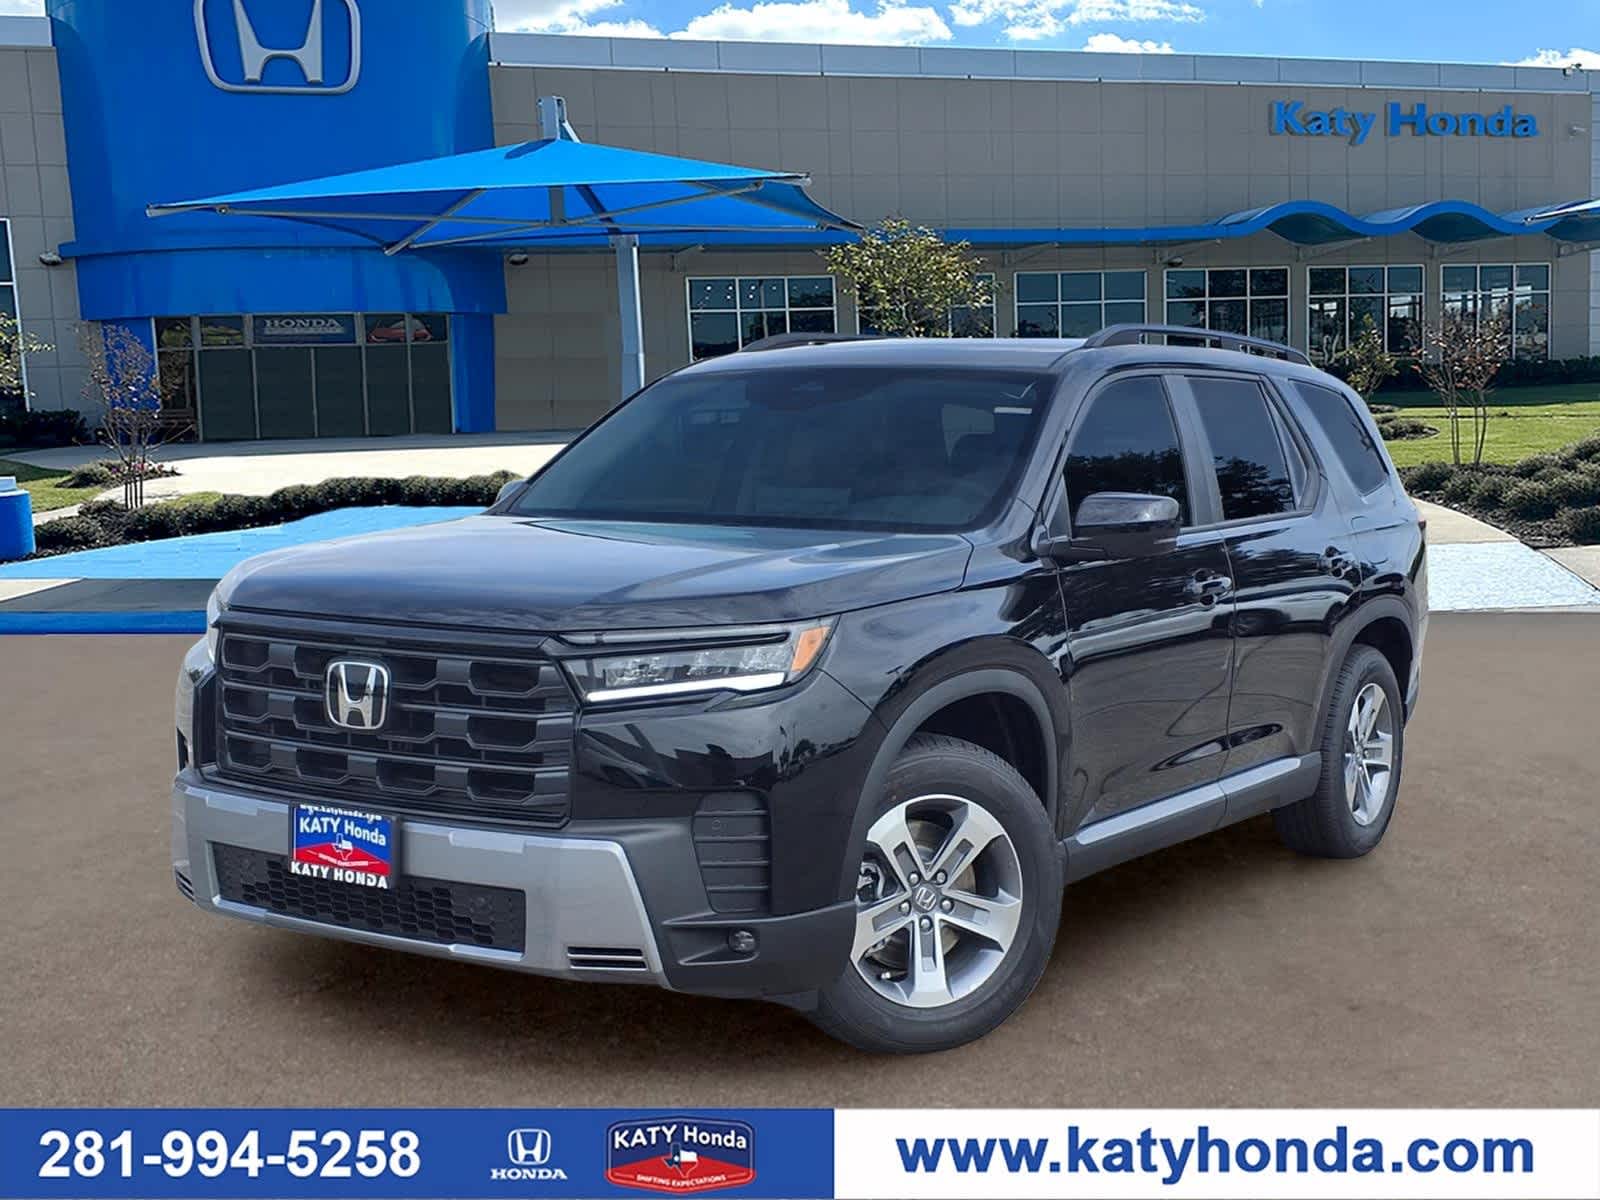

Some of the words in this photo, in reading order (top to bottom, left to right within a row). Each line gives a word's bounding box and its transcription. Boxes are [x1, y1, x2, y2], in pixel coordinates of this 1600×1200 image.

[1271, 101, 1376, 146] Katy
[1384, 102, 1540, 138] Honda
[264, 319, 341, 327] HONDA
[300, 817, 341, 833] KATY
[344, 819, 387, 846] Honda
[291, 861, 329, 879] KATY
[333, 868, 388, 889] HONDA
